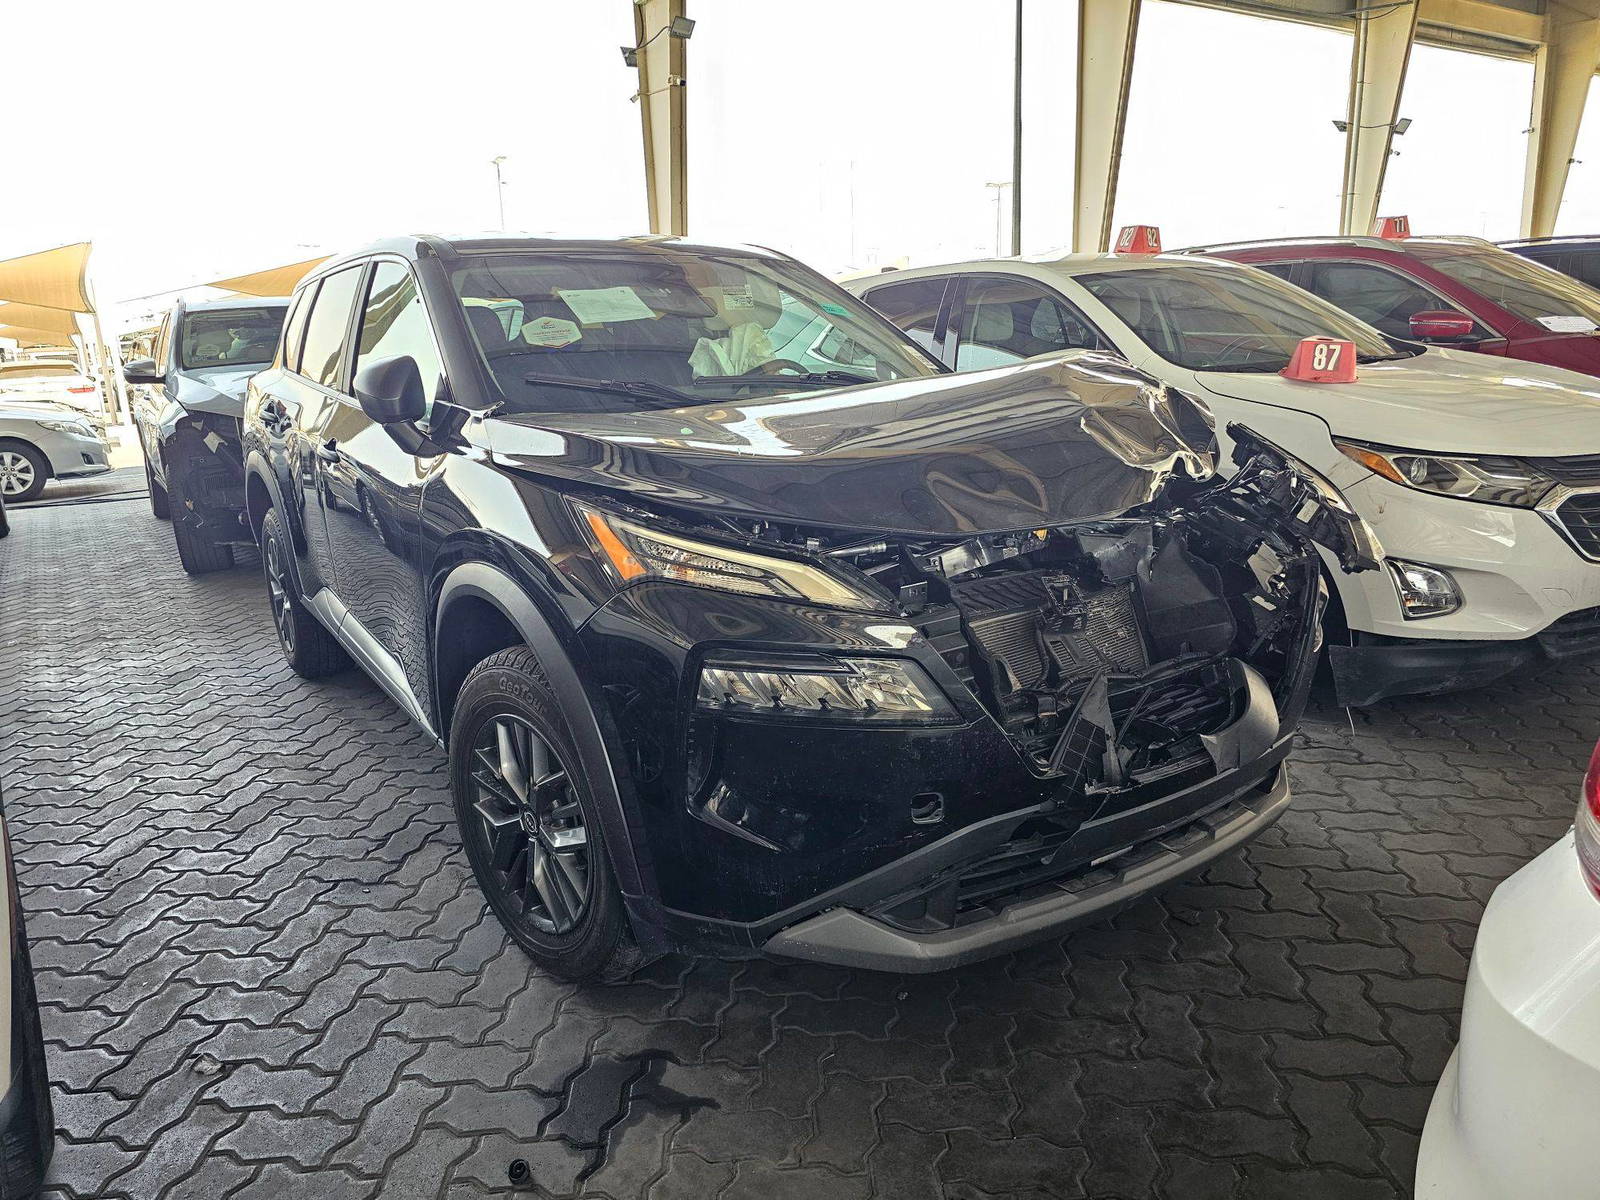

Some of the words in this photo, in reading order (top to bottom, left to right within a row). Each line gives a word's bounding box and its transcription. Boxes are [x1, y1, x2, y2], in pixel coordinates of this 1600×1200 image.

[1394, 217, 1404, 233] 77
[1120, 228, 1134, 247] 82
[1147, 228, 1158, 247] 82
[1313, 344, 1341, 371] 87
